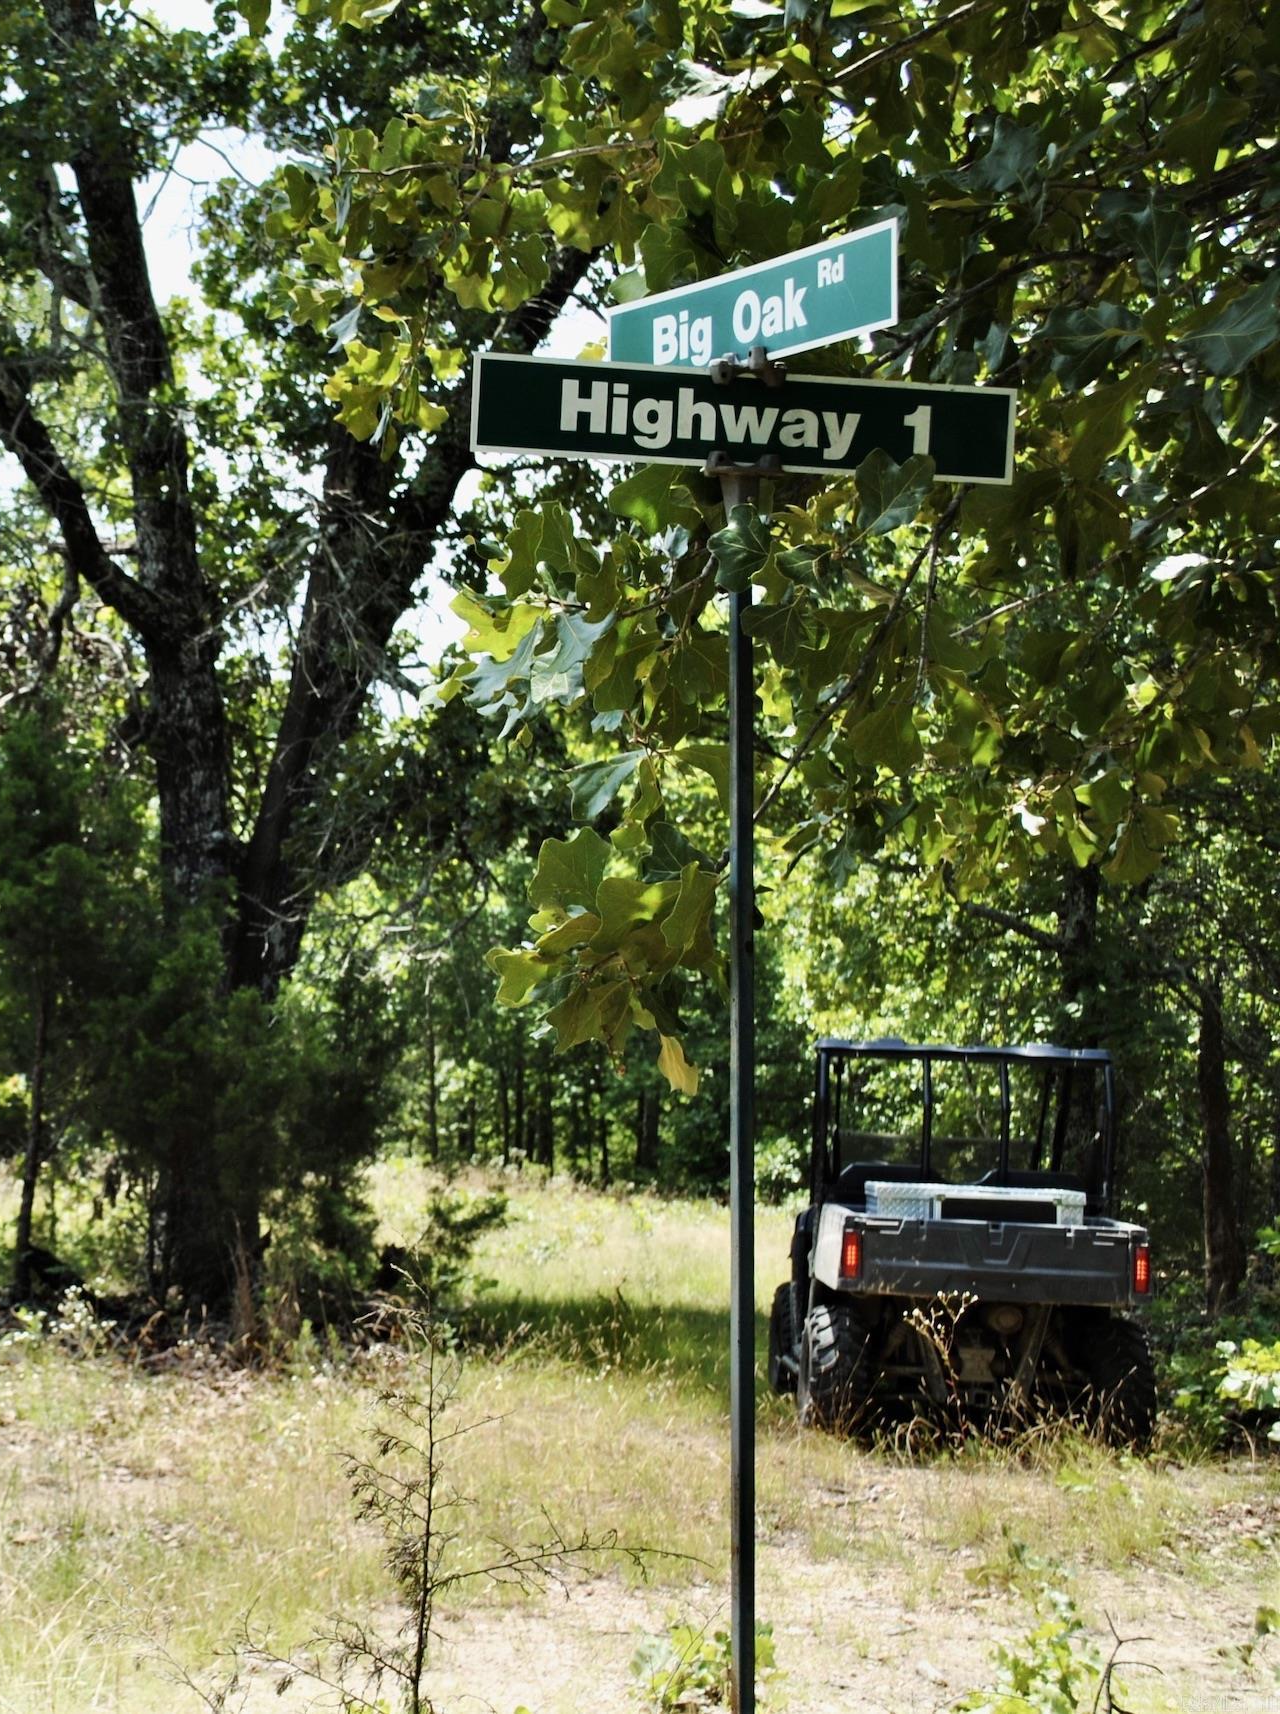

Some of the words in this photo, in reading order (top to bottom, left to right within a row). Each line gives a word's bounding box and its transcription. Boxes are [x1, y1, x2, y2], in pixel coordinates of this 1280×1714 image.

[652, 310, 712, 366] Big
[732, 278, 808, 344] Oak
[817, 253, 845, 288] Rd
[559, 378, 861, 461] Highway
[904, 404, 932, 456] 1
